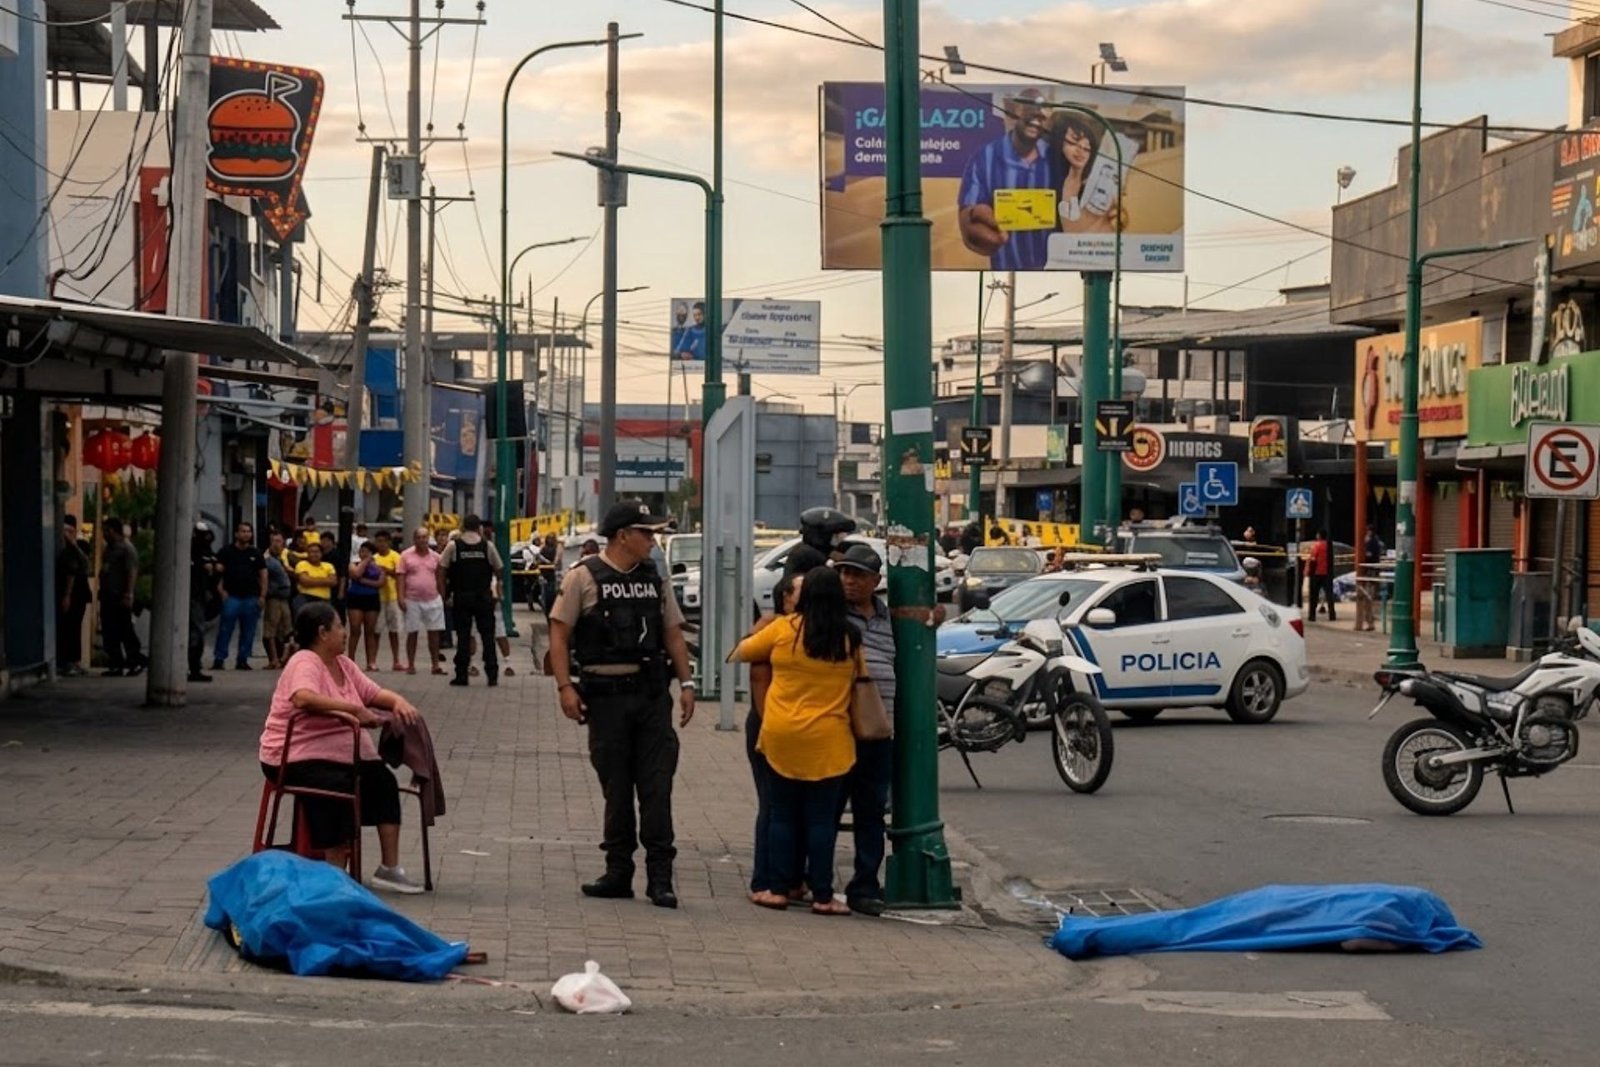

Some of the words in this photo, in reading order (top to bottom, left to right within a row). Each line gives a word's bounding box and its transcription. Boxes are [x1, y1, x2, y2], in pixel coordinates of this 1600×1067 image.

[1549, 440, 1580, 478] E
[602, 582, 658, 599] POLICIA
[1121, 651, 1221, 672] POLICIA
